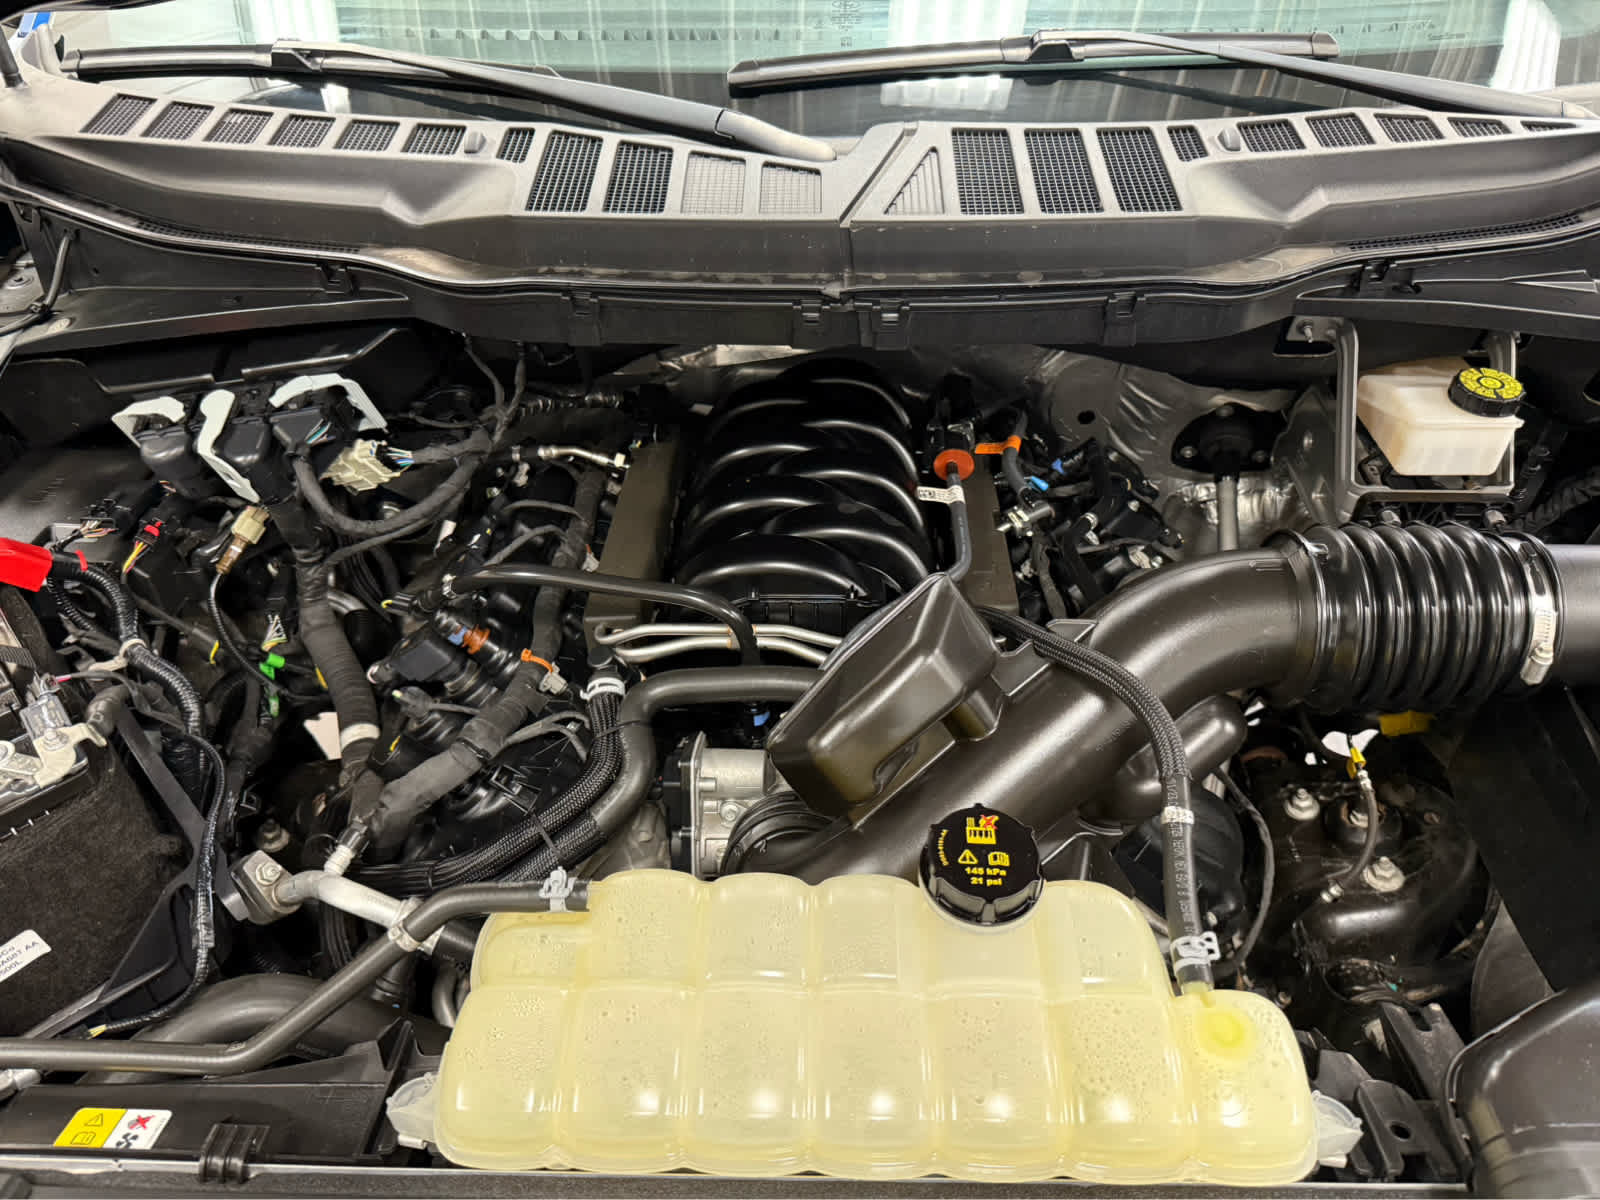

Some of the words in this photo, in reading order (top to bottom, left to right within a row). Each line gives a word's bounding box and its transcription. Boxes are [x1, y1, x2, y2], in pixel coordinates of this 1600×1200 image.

[965, 867, 985, 875] 145
[986, 867, 1007, 877] kPa
[970, 876, 984, 885] 21
[986, 878, 1003, 887] psi
